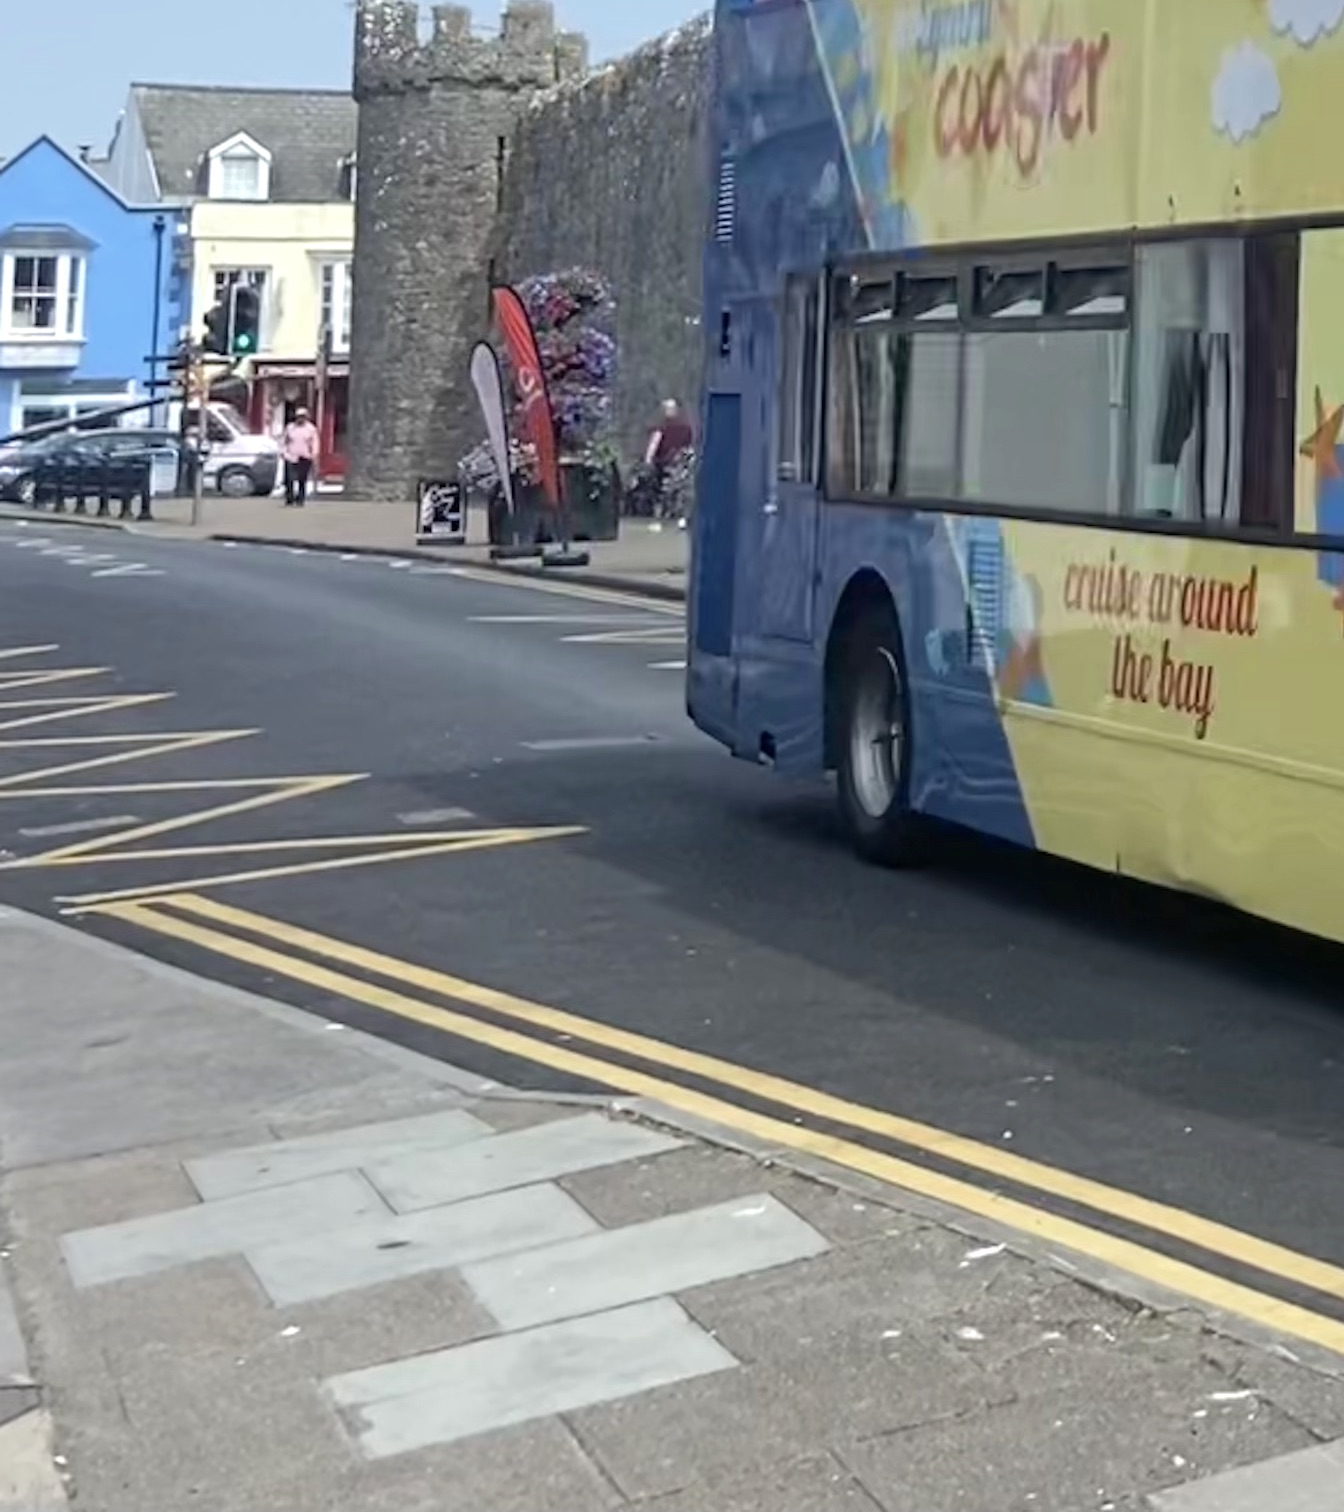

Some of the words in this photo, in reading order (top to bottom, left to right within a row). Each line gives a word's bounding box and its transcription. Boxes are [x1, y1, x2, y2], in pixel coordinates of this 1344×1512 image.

[1064, 546, 1141, 620] cruise
[1149, 564, 1258, 636] around
[1112, 633, 1153, 703] the
[1158, 638, 1215, 741] bay
